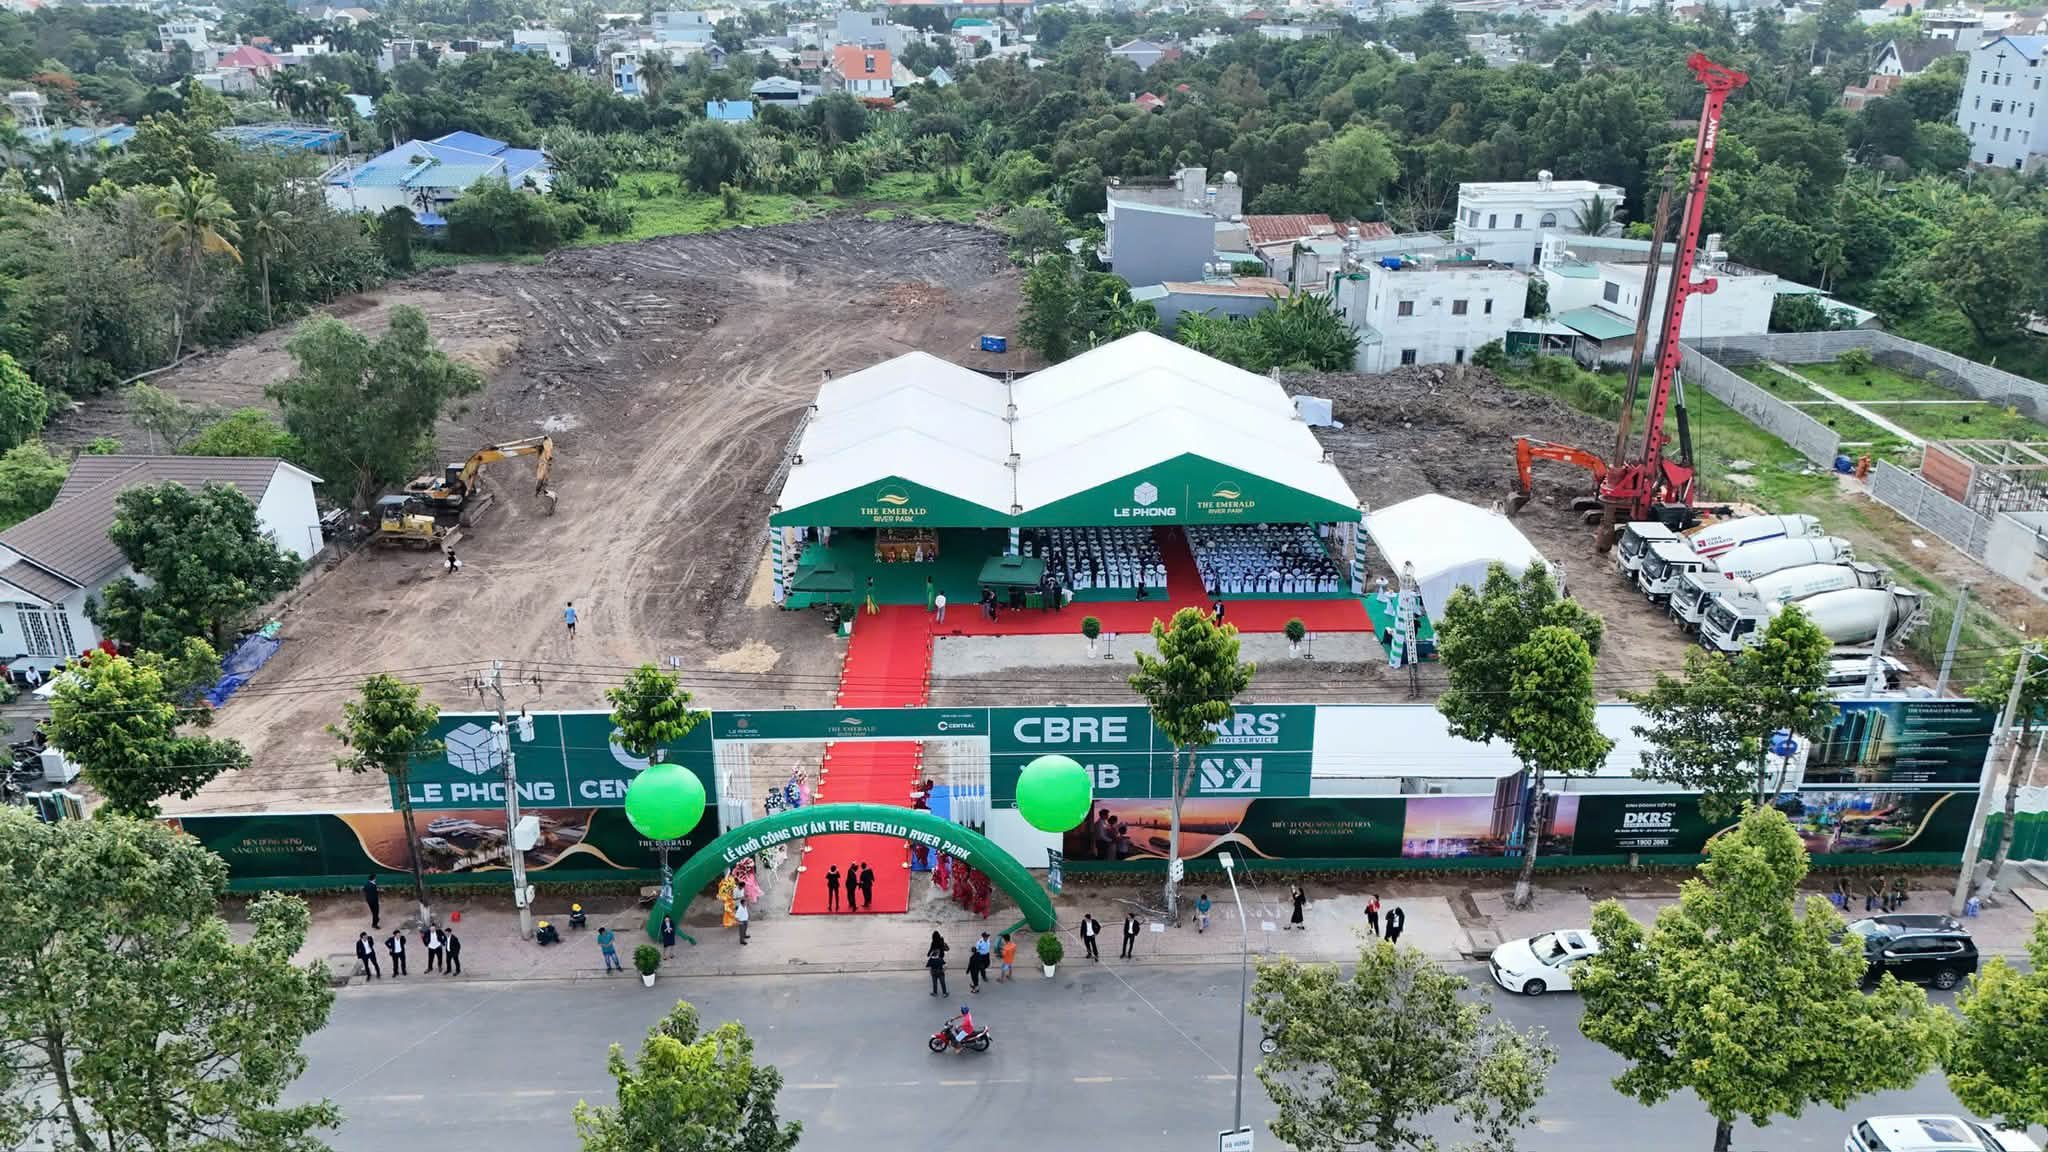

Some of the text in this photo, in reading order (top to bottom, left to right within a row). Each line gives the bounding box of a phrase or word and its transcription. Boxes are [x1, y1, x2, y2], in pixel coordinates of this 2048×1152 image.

[1704, 113, 1719, 149] SANY
[860, 507, 927, 515] THE EMERALD
[1113, 507, 1177, 517] LE PHONG
[1013, 716, 1128, 743] CBRE
[407, 783, 442, 803] LE
[1624, 812, 1673, 824] DKRS
[760, 828, 791, 847] CÔNG
[829, 820, 850, 832] THE
[853, 820, 908, 836] EMERALD
[909, 828, 941, 848] RVIER
[941, 839, 972, 860] PARK
